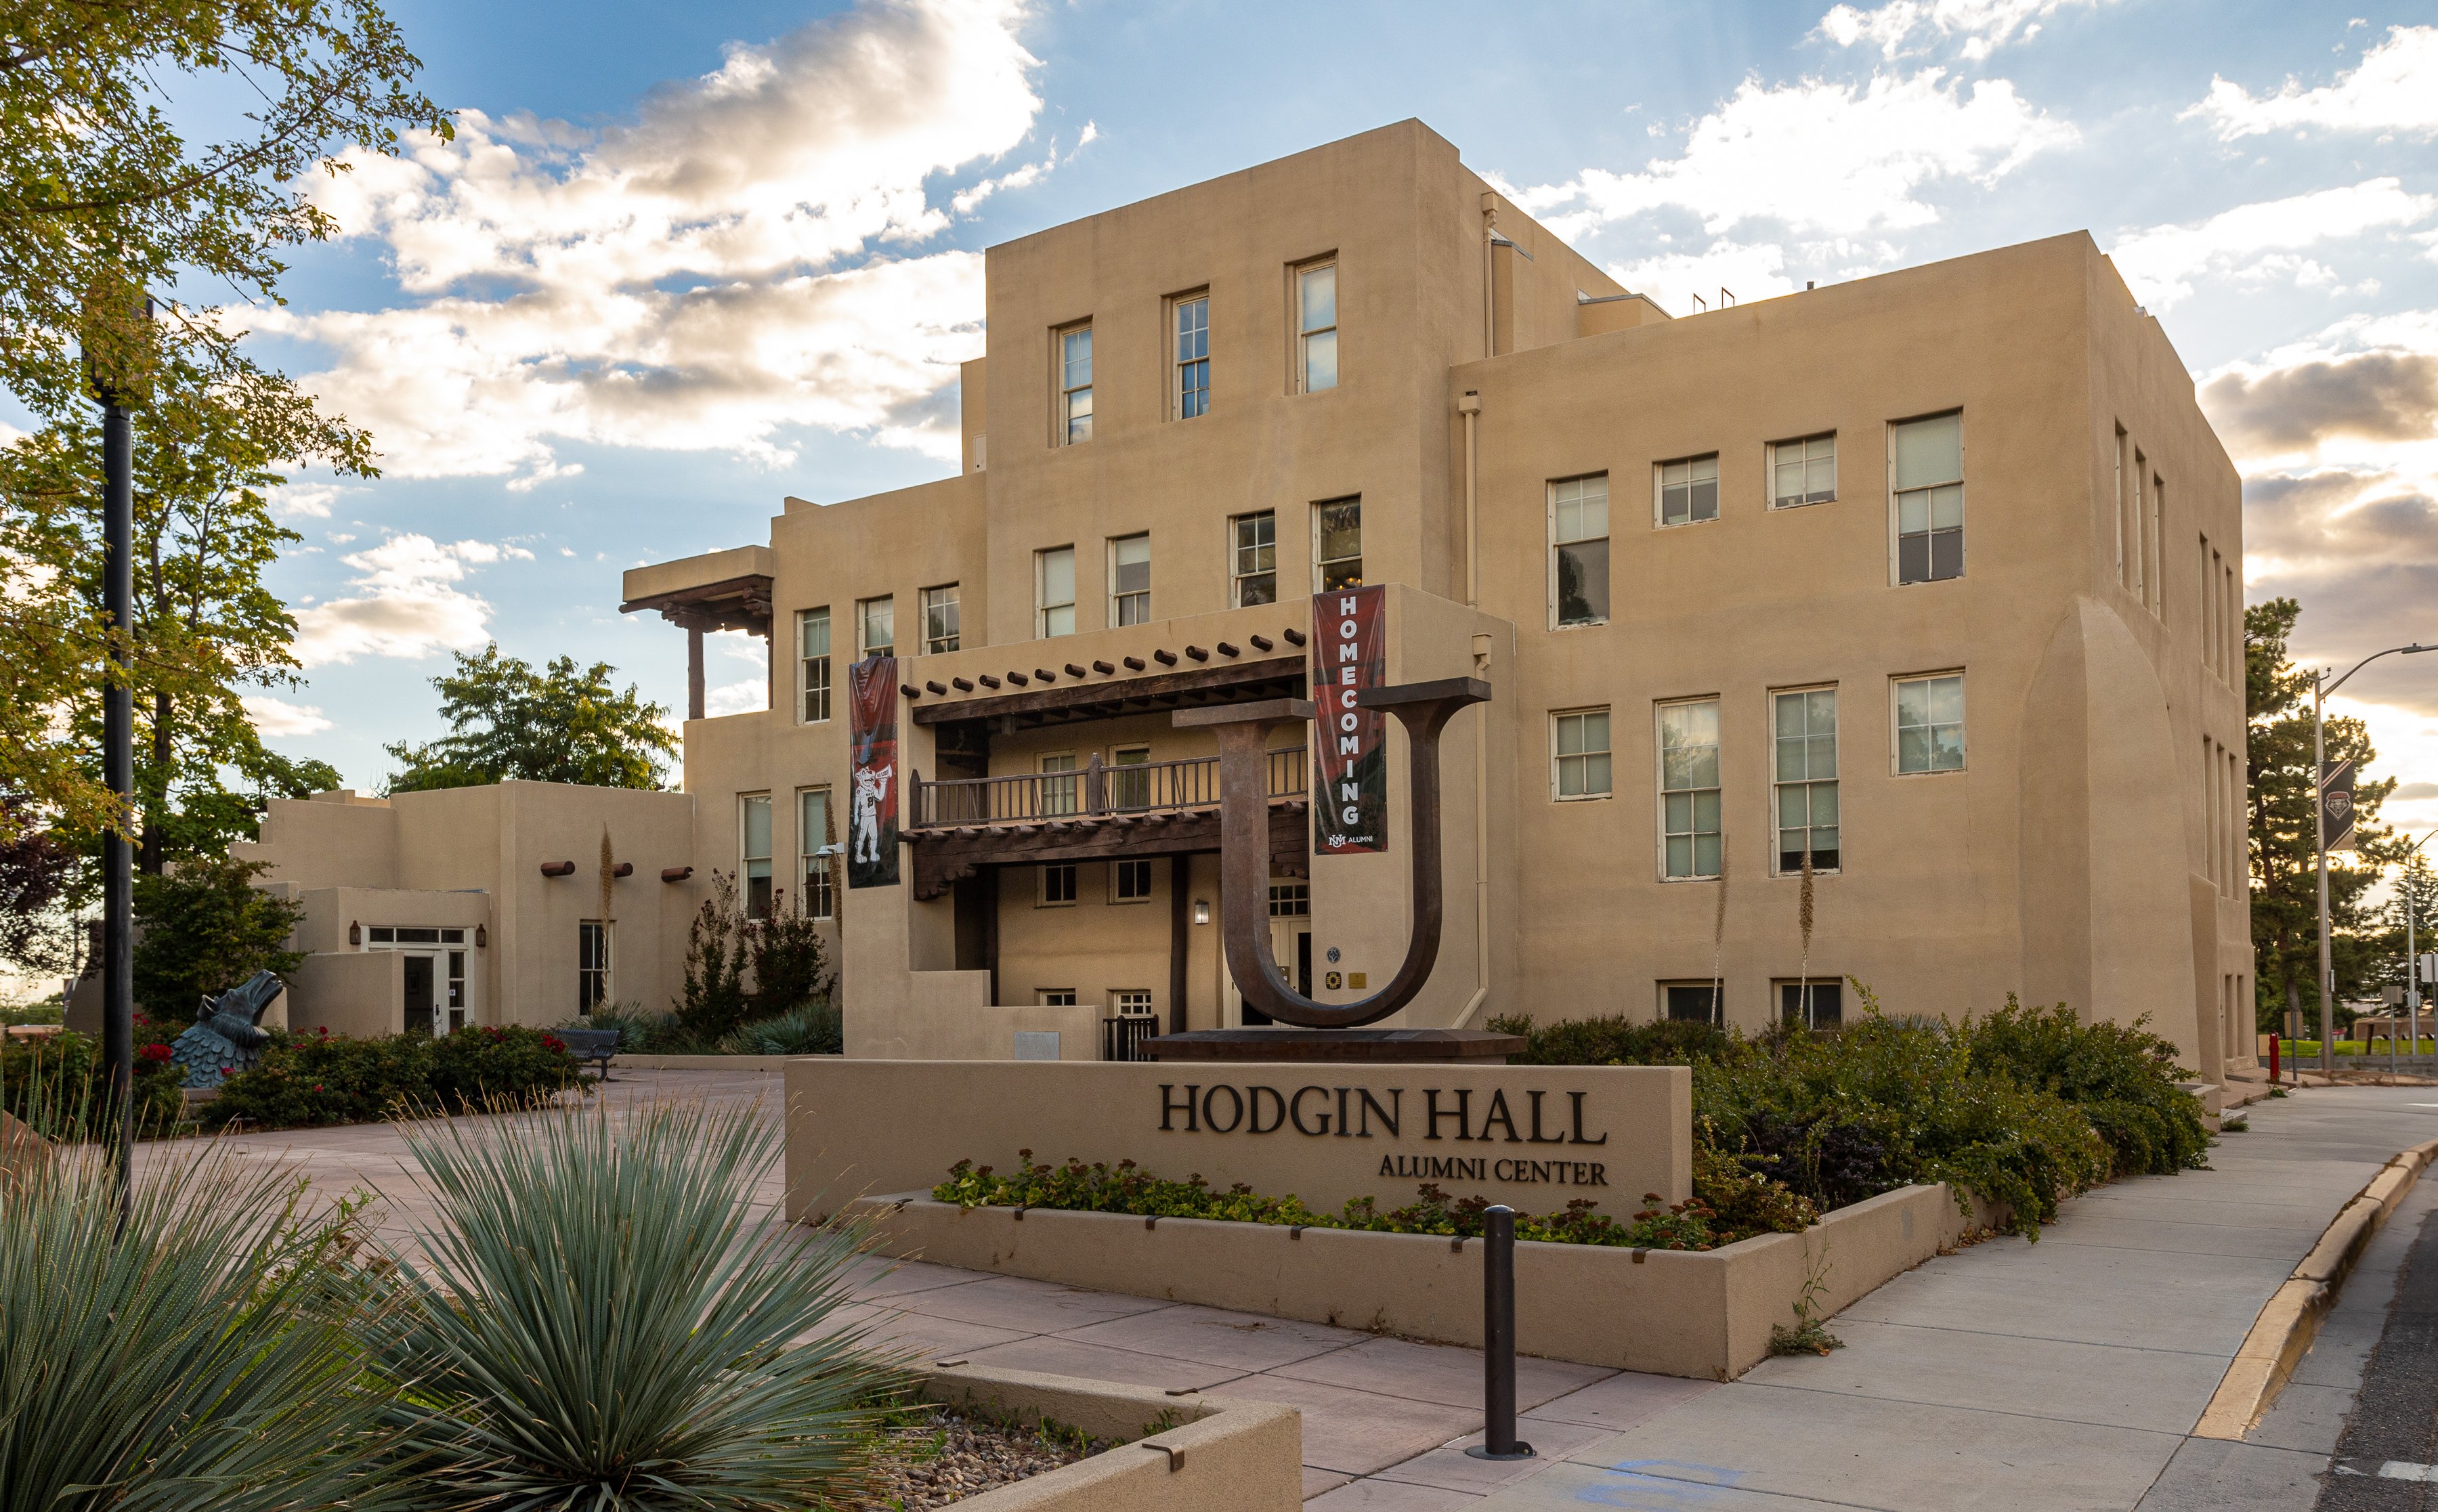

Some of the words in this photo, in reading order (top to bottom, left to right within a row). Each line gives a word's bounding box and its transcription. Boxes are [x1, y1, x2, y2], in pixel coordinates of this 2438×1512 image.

[1339, 596, 1359, 825] HOMECOMING
[1348, 835, 1373, 844] ALUMNI
[1157, 1084, 1404, 1138] HODGIN
[1422, 1087, 1608, 1144] HALL
[1378, 1154, 1487, 1180] ALUMNI
[1493, 1158, 1610, 1186] CENTER
